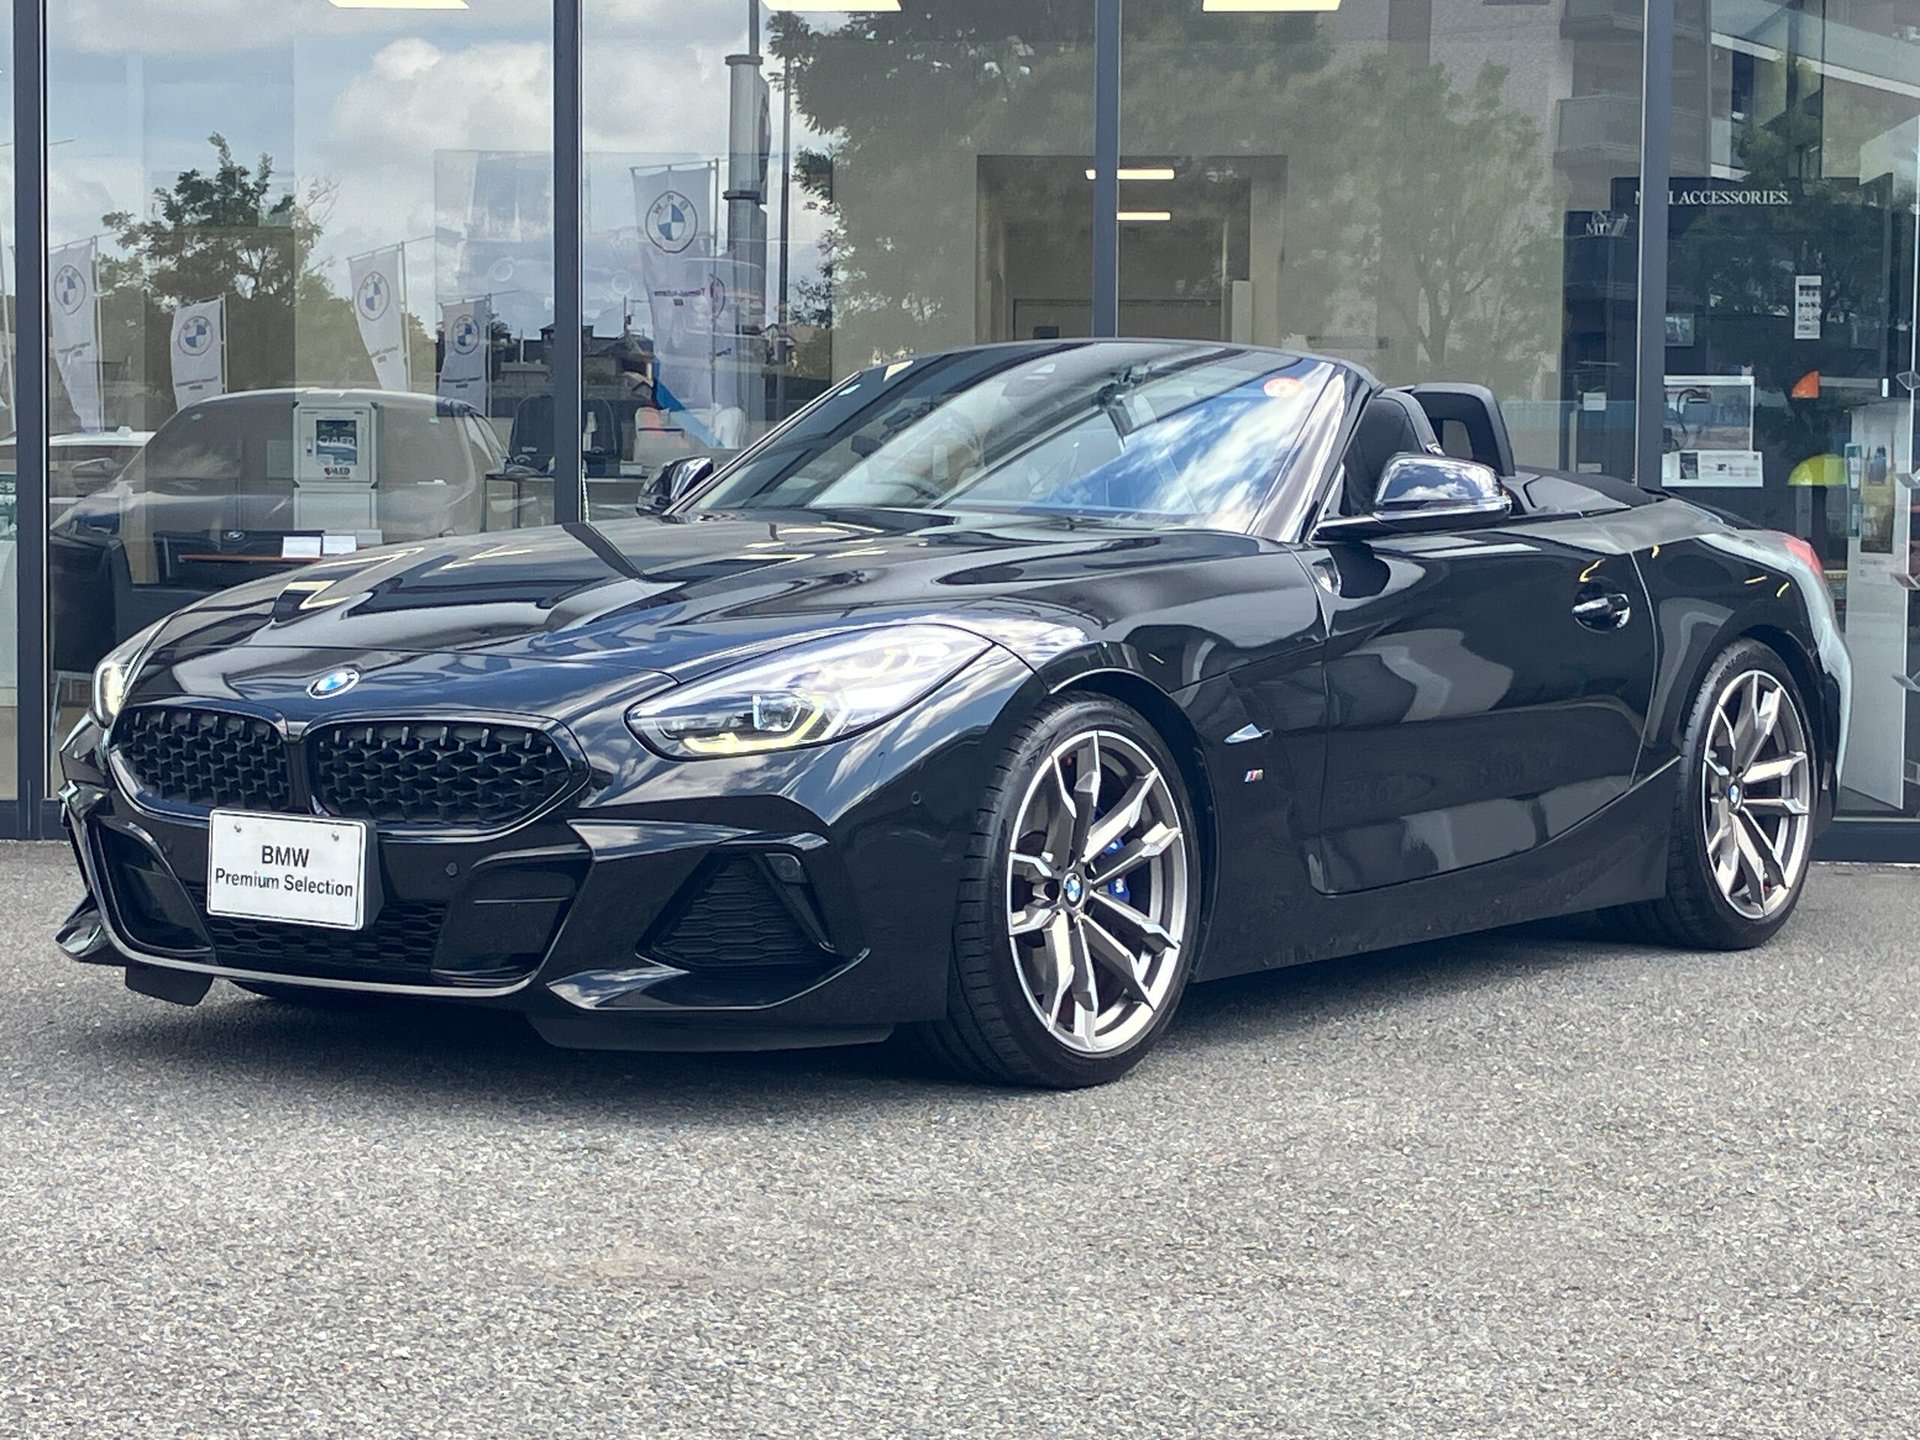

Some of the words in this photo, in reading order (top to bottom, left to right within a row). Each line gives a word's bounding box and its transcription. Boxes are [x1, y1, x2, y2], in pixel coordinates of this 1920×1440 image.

[261, 845, 310, 868] BMW
[215, 868, 279, 889] Premium
[284, 874, 353, 897] Selection
